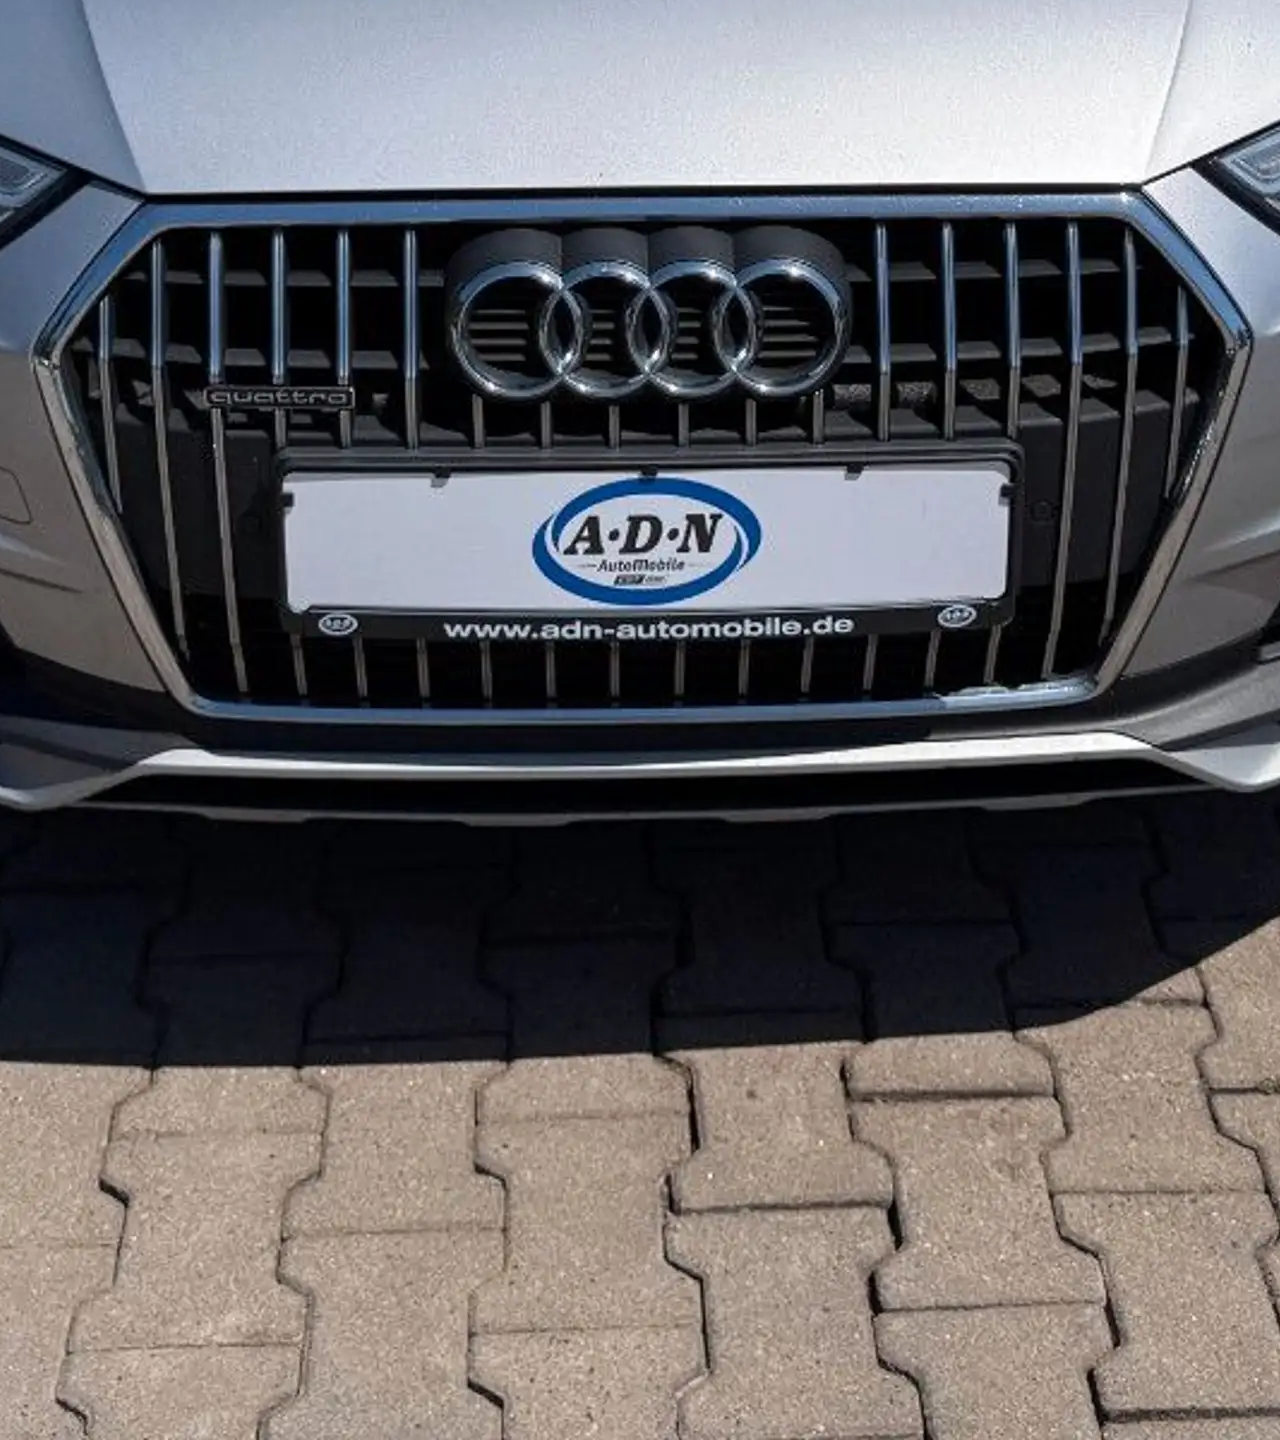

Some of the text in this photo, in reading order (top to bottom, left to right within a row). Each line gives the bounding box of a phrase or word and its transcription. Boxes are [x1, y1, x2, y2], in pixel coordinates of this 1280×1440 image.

[210, 391, 347, 404] quattro
[597, 558, 685, 572] AutoMobile
[444, 616, 854, 641] www.adn-automobile.de
